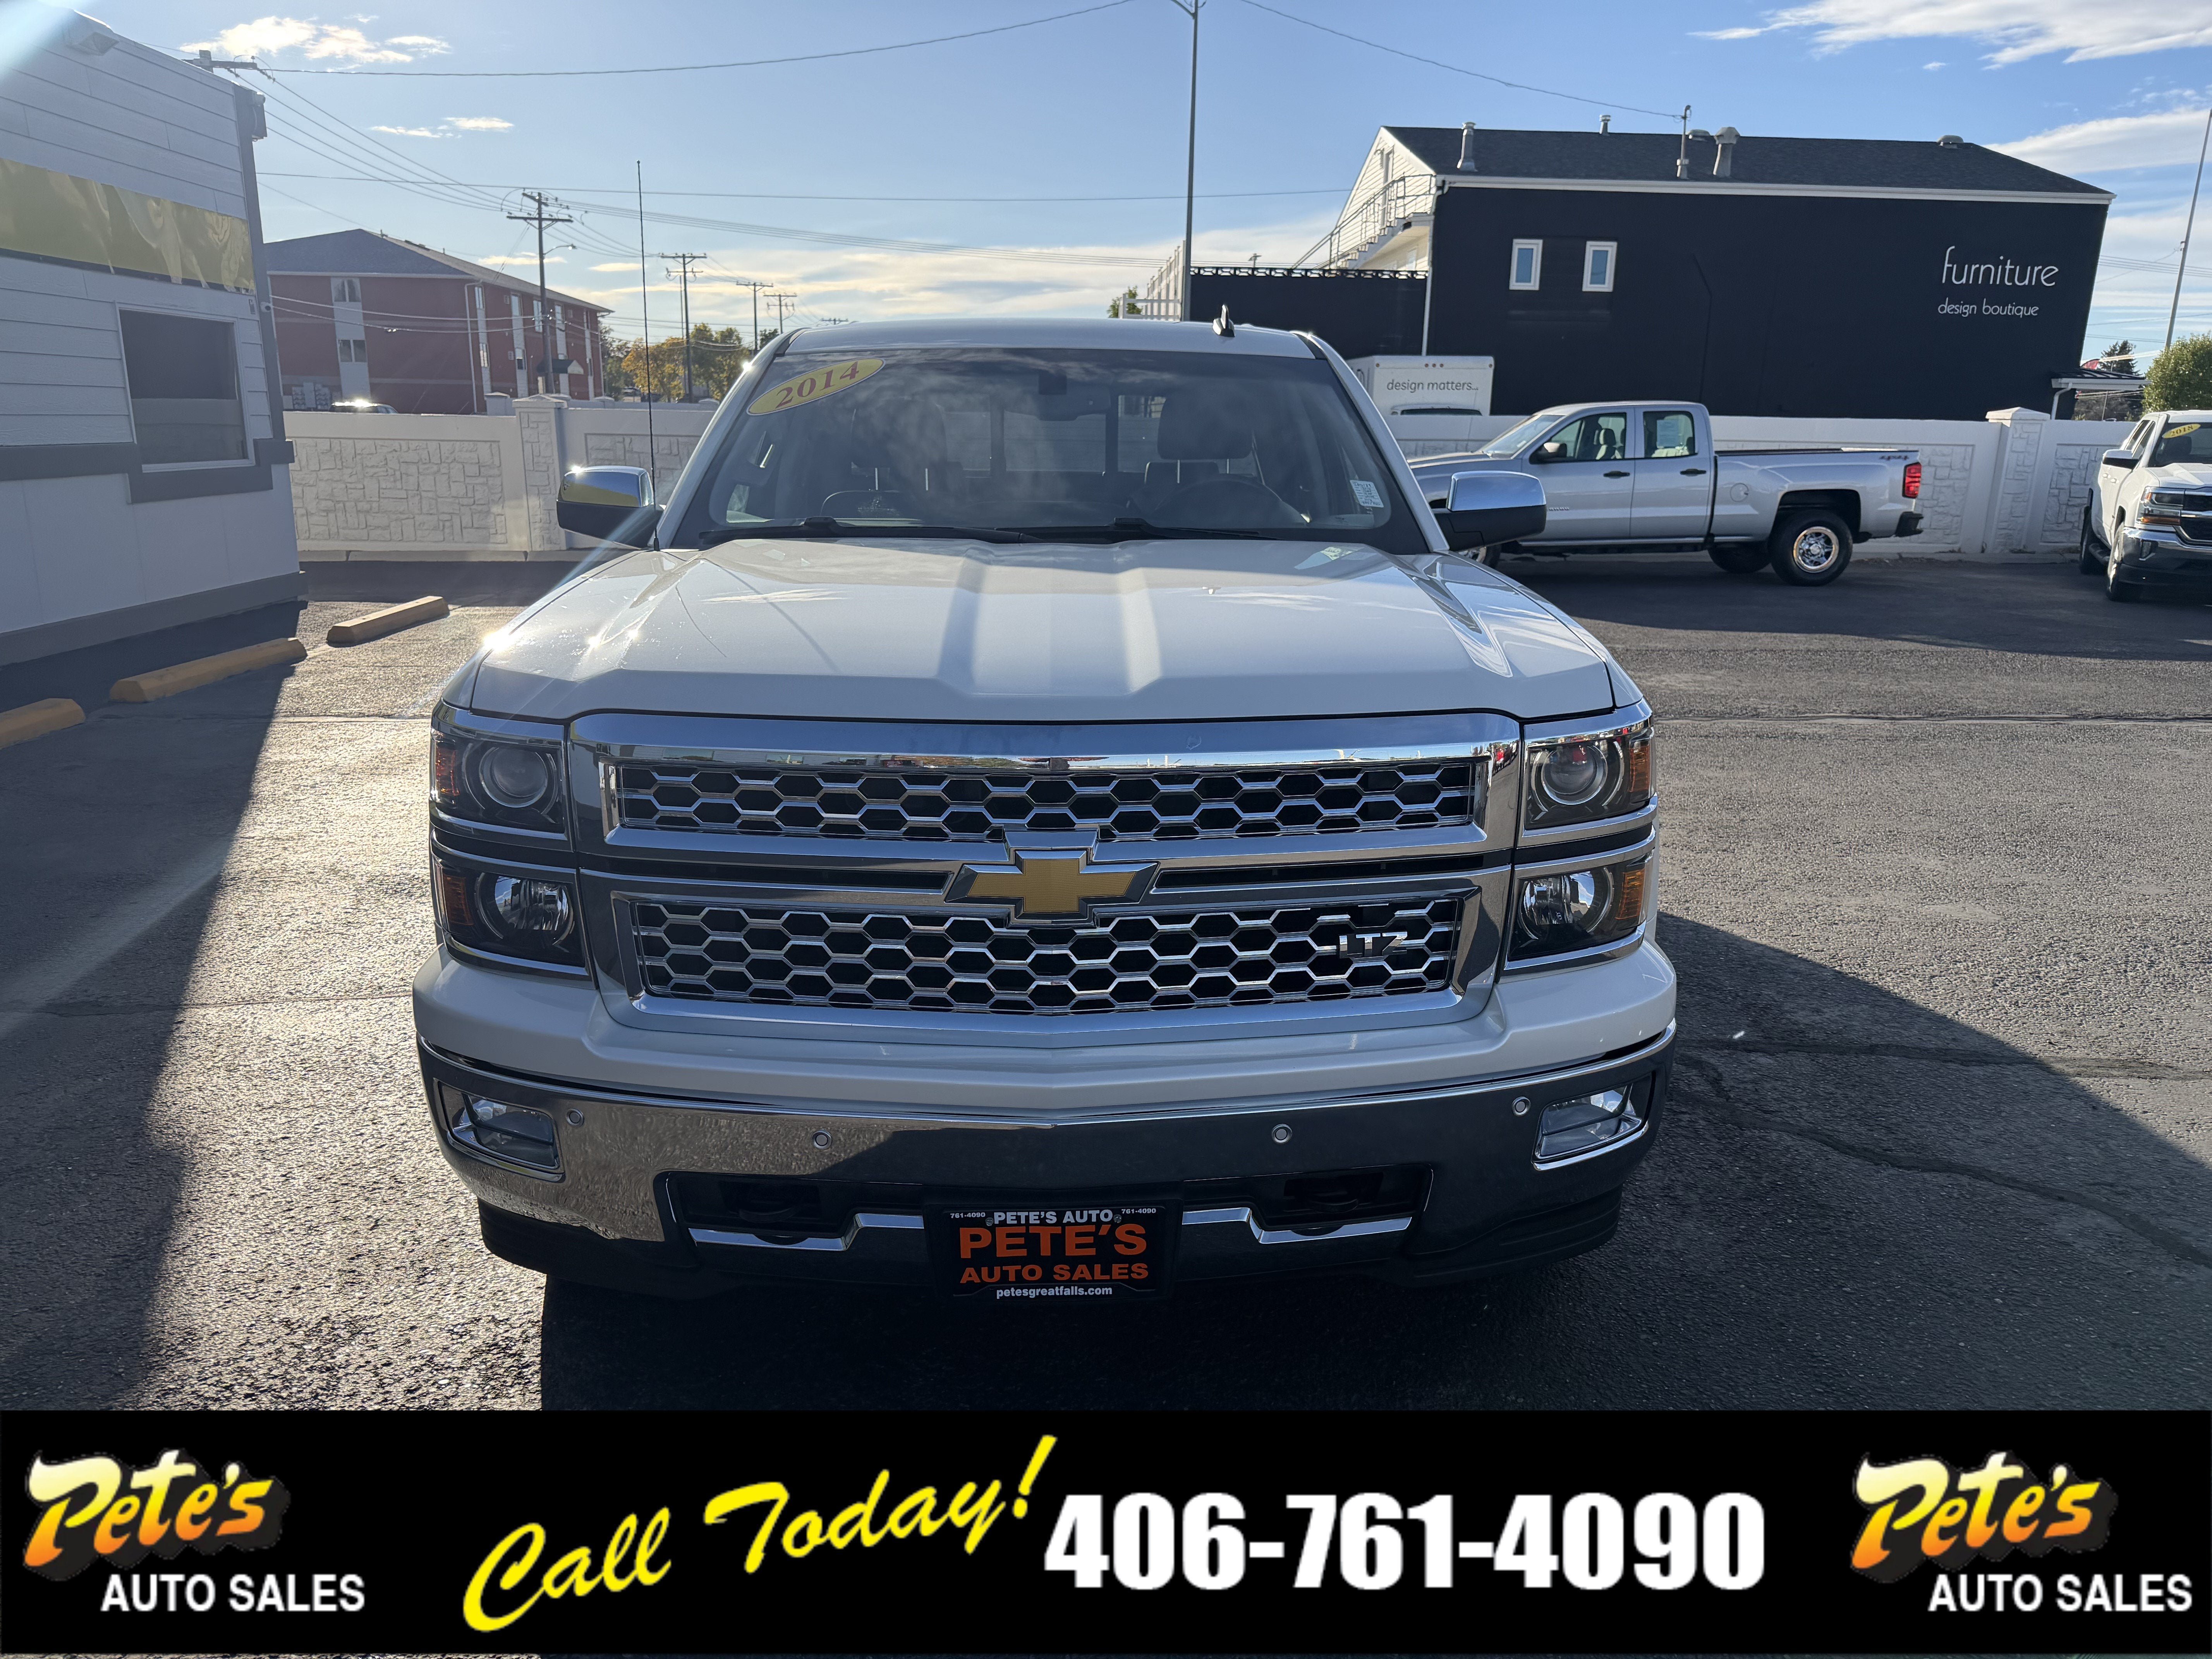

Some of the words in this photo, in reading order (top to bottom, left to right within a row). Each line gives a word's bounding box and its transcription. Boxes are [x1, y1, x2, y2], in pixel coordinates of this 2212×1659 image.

[1942, 246, 2059, 286] furniture
[1938, 297, 1977, 317] design
[1982, 298, 2039, 318] boutique
[775, 361, 859, 409] 2014
[1387, 379, 1423, 393] design
[1427, 380, 1479, 390] matters...
[2171, 425, 2193, 436] 2018
[1340, 931, 1407, 958] LTZ
[994, 1211, 1057, 1224] PETE'S
[1062, 1209, 1113, 1223] AUTO
[960, 1223, 1147, 1259] PETE'S
[960, 1264, 1043, 1284] AUTO
[1053, 1263, 1149, 1280] SALES
[996, 1286, 1113, 1299] petesgreatfalls.com
